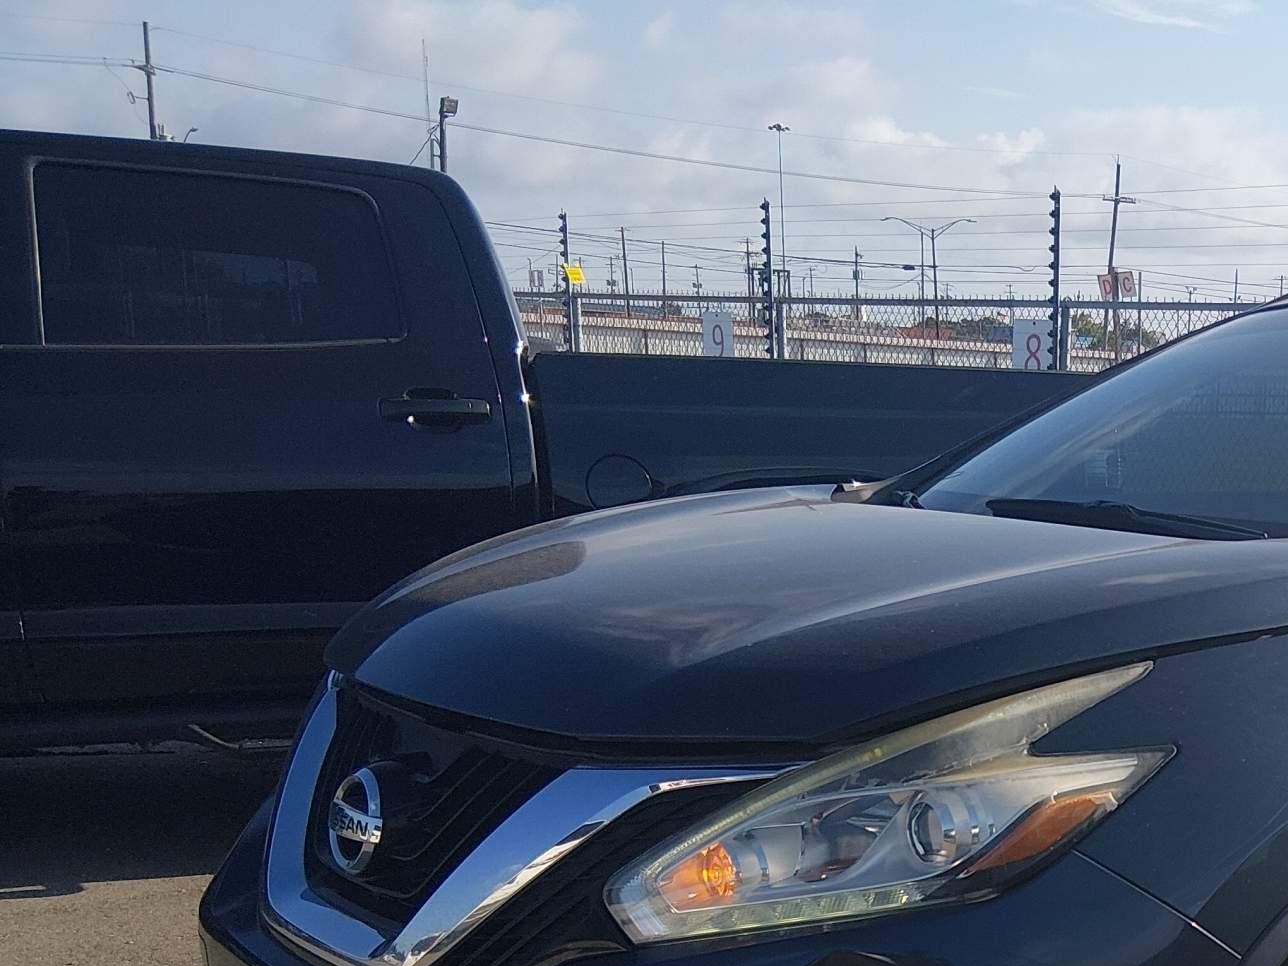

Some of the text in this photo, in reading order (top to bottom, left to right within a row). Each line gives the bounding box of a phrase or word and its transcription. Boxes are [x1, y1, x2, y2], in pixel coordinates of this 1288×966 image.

[1103, 279, 1113, 295] D
[1122, 276, 1133, 293] C
[712, 324, 724, 357] 9
[1025, 333, 1041, 370] 8
[329, 805, 369, 837] SSAN
